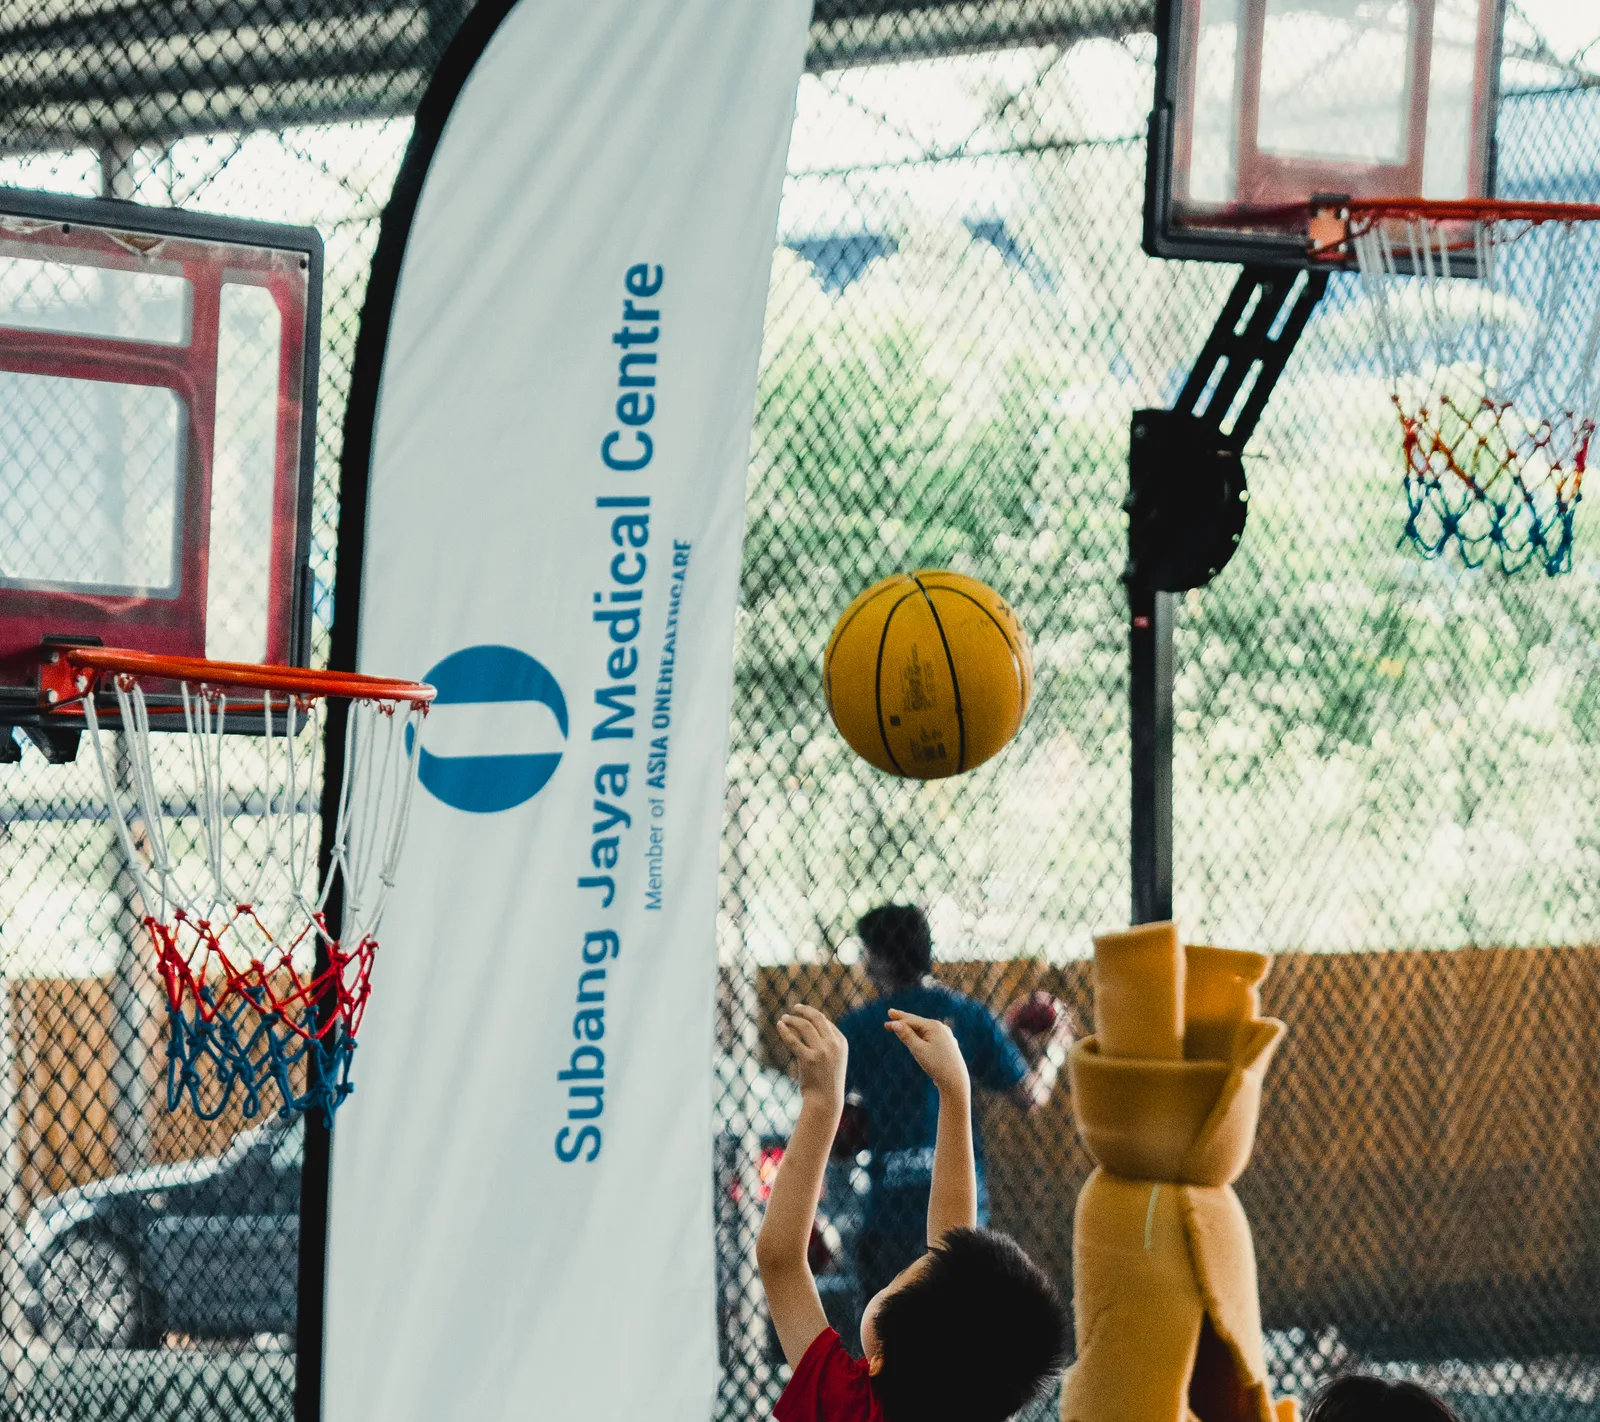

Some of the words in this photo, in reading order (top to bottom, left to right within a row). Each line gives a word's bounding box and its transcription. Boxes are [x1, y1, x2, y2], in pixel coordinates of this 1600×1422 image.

[599, 262, 666, 473] Centre
[590, 495, 652, 742] Medical
[576, 762, 633, 910] Jaya
[645, 735, 670, 791] ASIA
[647, 797, 665, 818] of
[644, 825, 665, 911] Member
[553, 928, 621, 1165] Subang
